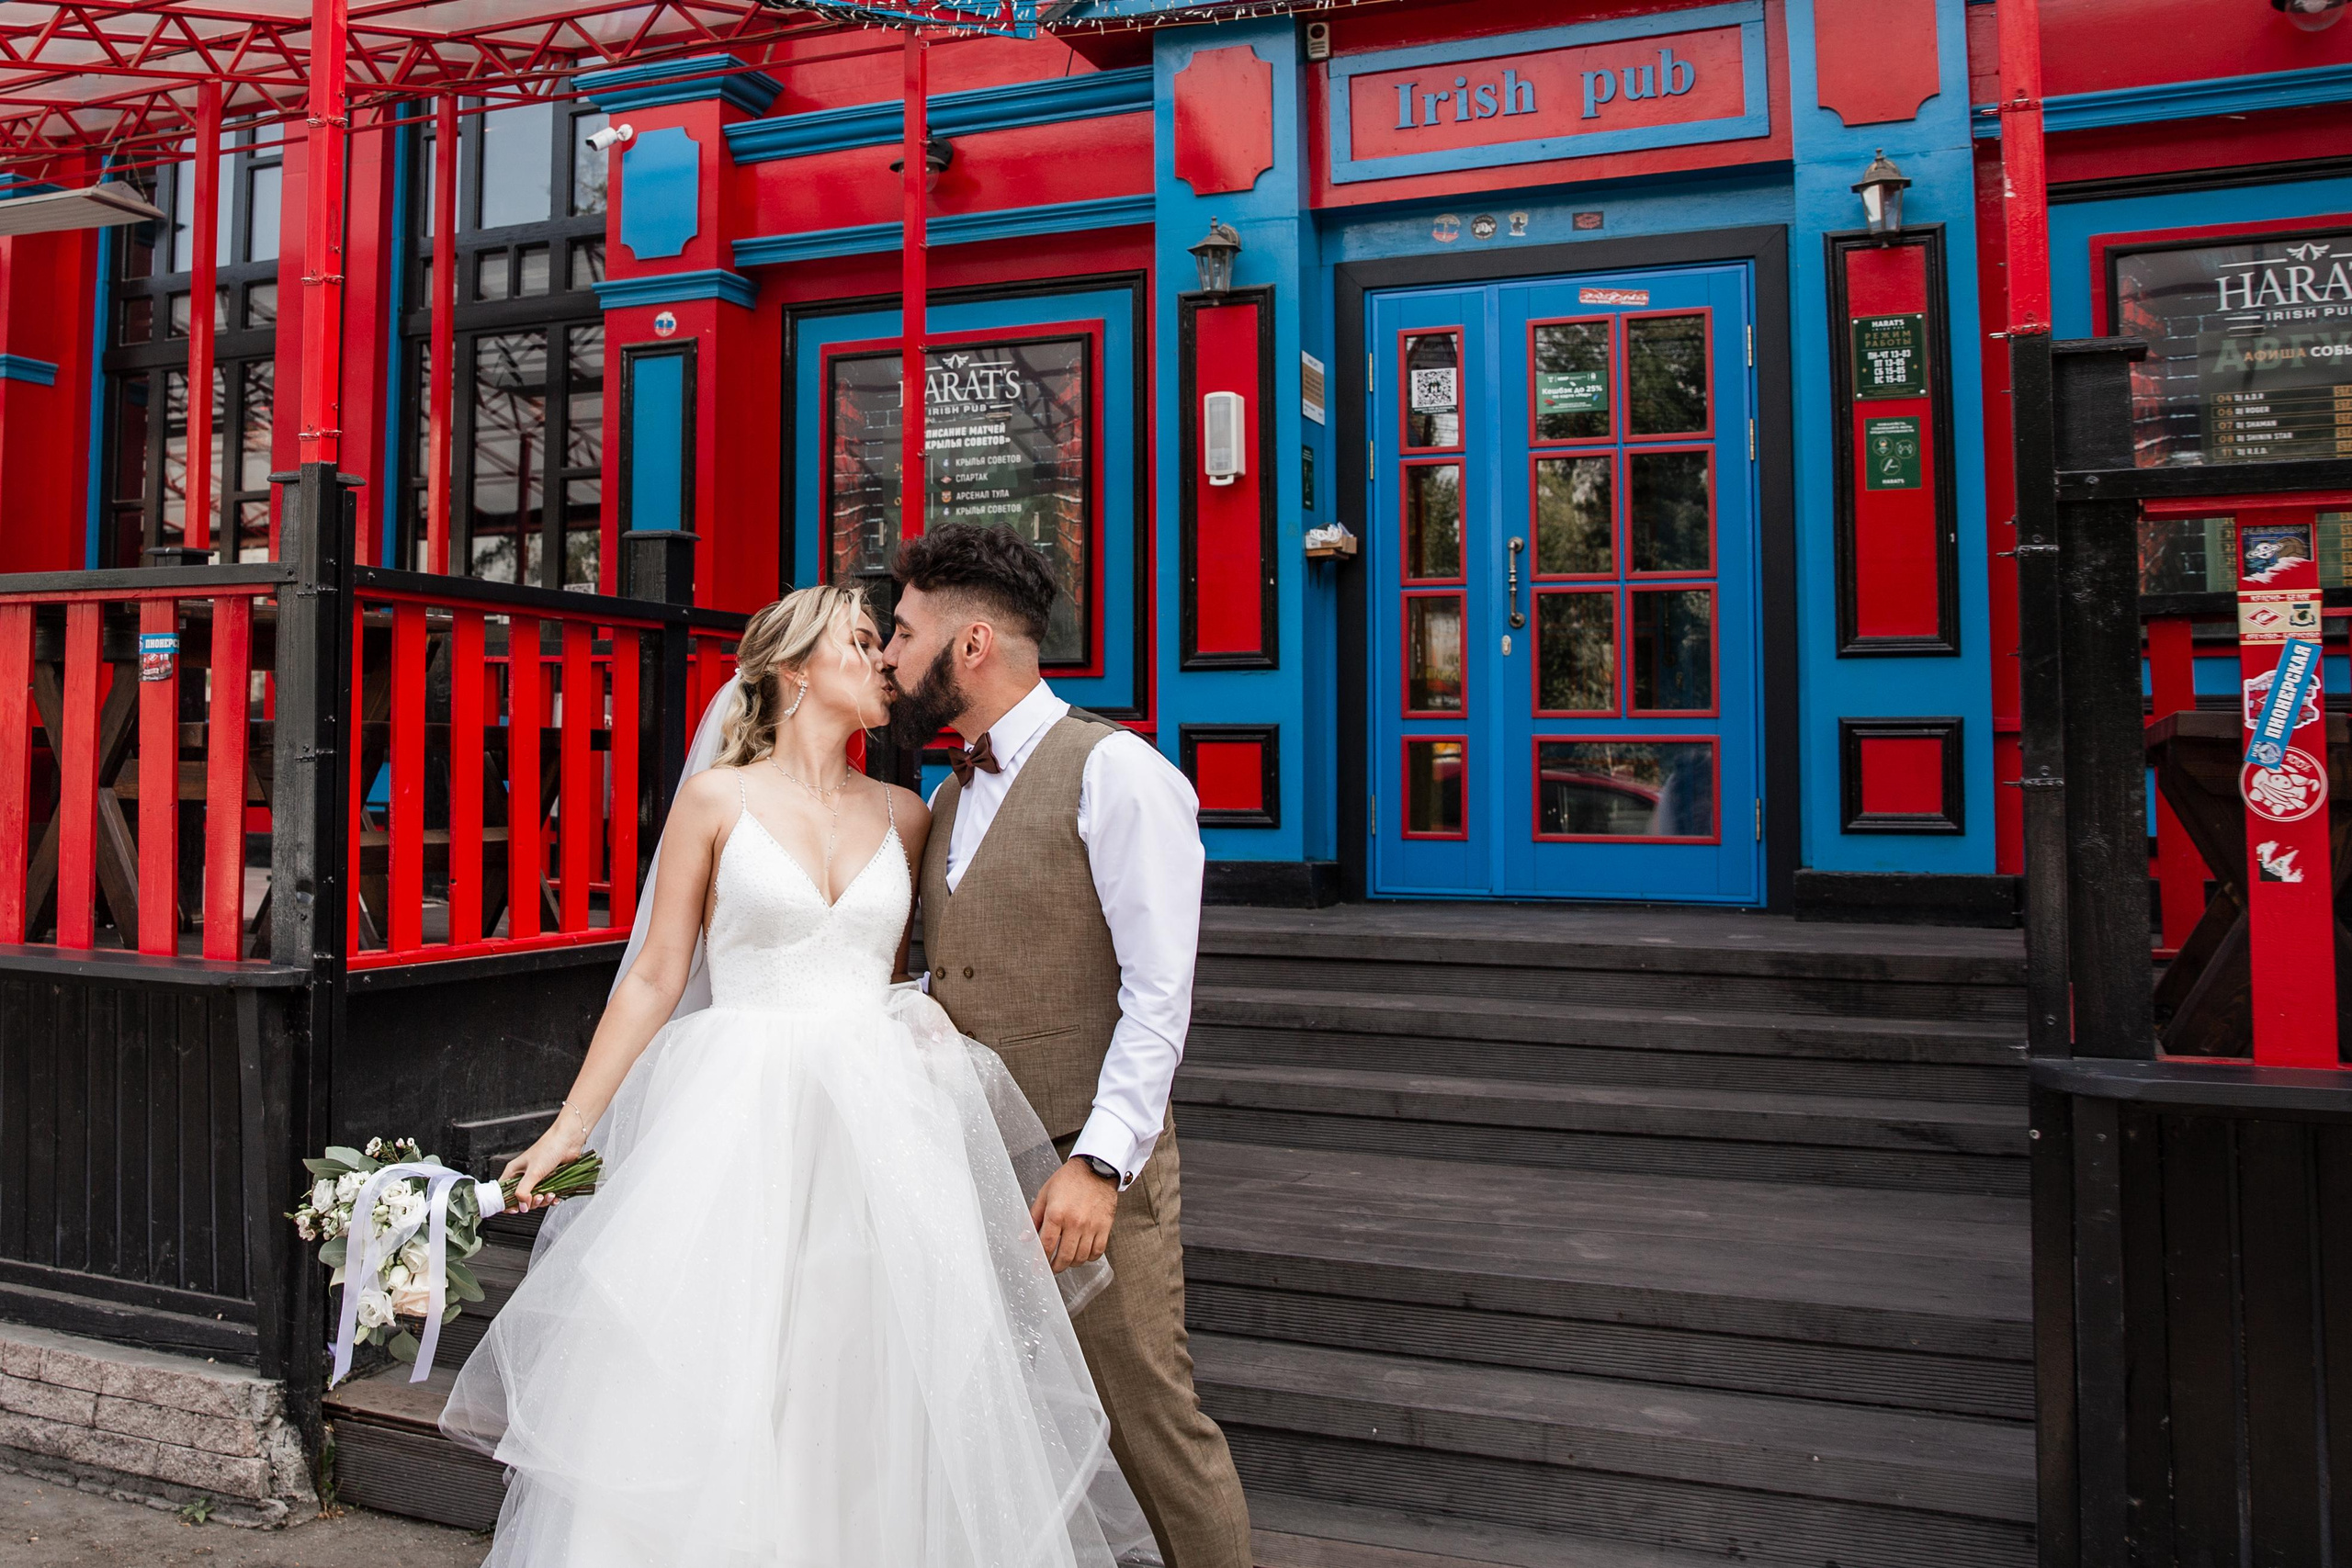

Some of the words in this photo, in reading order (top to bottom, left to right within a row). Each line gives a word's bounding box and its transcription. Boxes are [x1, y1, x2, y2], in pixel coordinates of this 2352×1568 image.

[1394, 69, 1538, 130] Irish
[1580, 49, 1696, 119] pub
[2215, 261, 2352, 312] HARA
[2266, 309, 2316, 321] IRISH
[1865, 330, 1911, 340] РЕЖИМ
[1865, 338, 1911, 348] РАБОТЫ
[2244, 347, 2307, 362] АФИША
[928, 406, 959, 416] IRISH
[963, 404, 987, 413] PUB
[925, 426, 967, 439] ПИСАНИЕ
[969, 422, 1006, 435] МАТЧЕЙ
[964, 435, 1012, 447] СОВЕТОВ»
[956, 457, 986, 467] КРЫЛЬЯ
[988, 455, 1022, 465] СОВЕТОВ
[956, 473, 989, 483] СПАРТАК
[956, 491, 989, 501] АРСЕНАЛ
[991, 490, 1010, 499] ТУЛА
[956, 506, 986, 516] КРЫЛЬЯ
[988, 504, 1022, 513] СОВЕТОВ
[2264, 644, 2312, 739] ПИОНЕРСКАЯ
[2285, 753, 2313, 773] 100%
